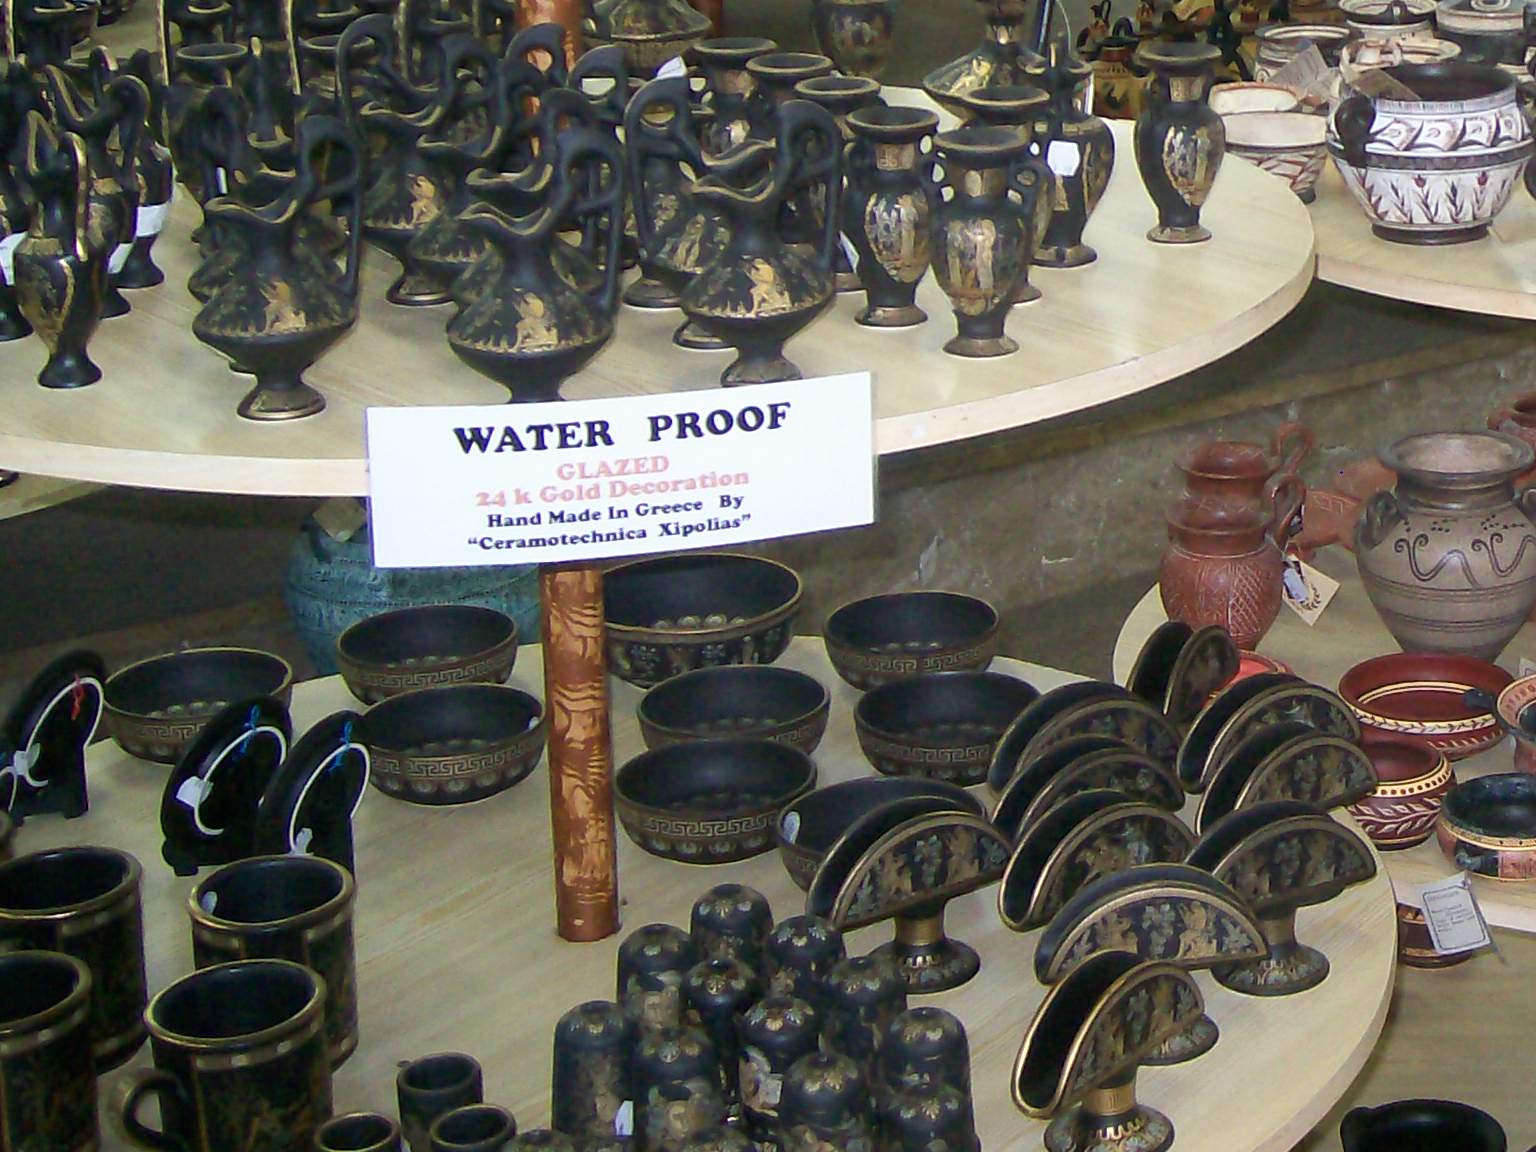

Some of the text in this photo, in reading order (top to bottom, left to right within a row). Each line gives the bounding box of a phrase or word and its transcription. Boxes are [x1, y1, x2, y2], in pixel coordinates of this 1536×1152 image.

[453, 401, 791, 454] WATER PROOF
[556, 455, 670, 481] GLAZED
[476, 491, 507, 507] 24
[540, 482, 601, 503] Gold
[609, 471, 750, 498] Decoration
[487, 494, 745, 528] Hand Made In Greece By
